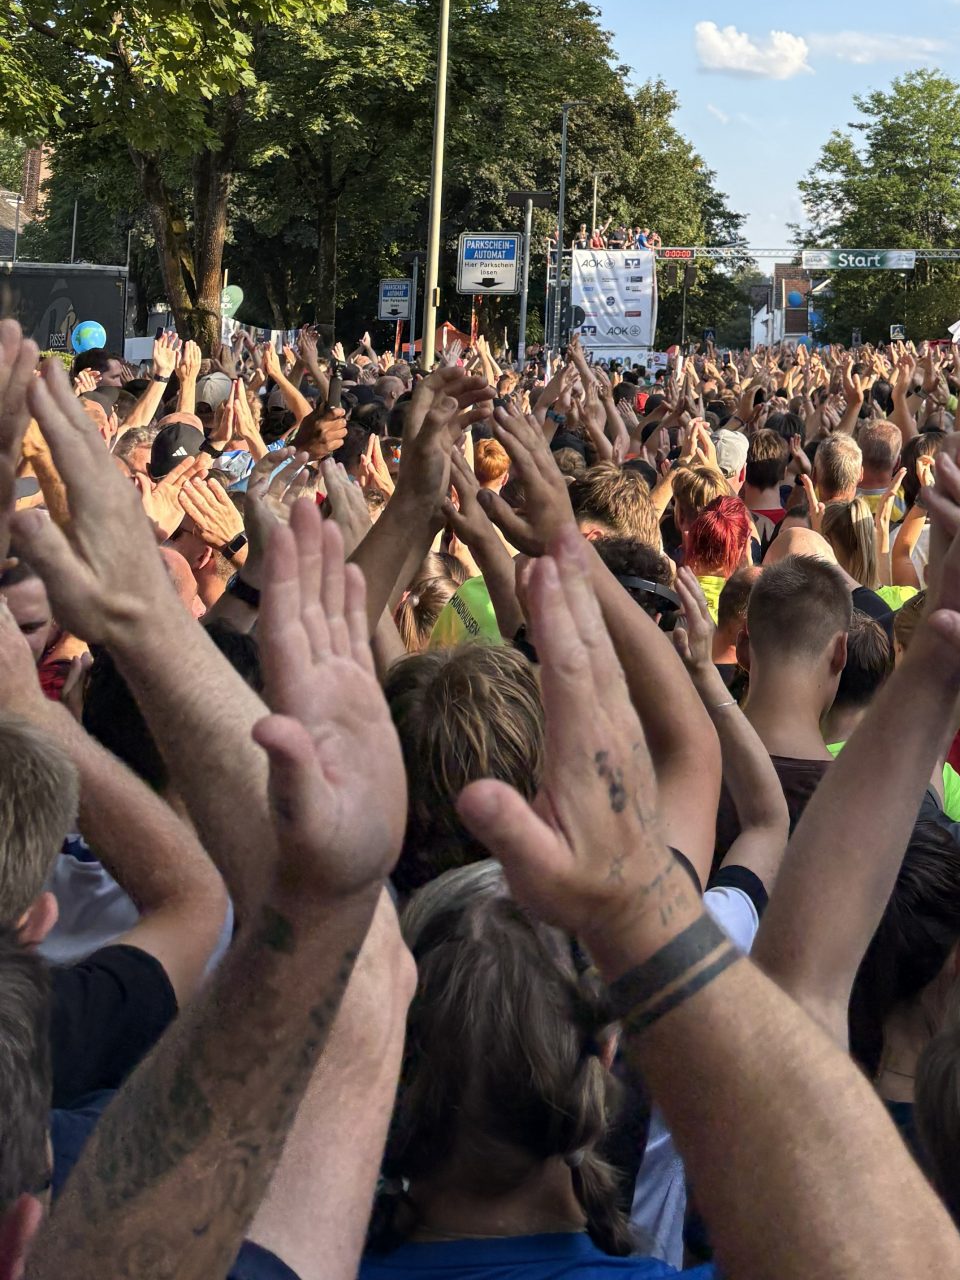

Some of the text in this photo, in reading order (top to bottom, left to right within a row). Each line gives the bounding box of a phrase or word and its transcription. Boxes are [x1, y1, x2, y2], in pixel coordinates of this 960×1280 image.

[466, 240, 514, 249] PARKSCHEIN-
[473, 250, 506, 259] AUTOMAT
[581, 260, 603, 268] AOK
[838, 253, 880, 267] Start
[606, 326, 628, 336] AOK
